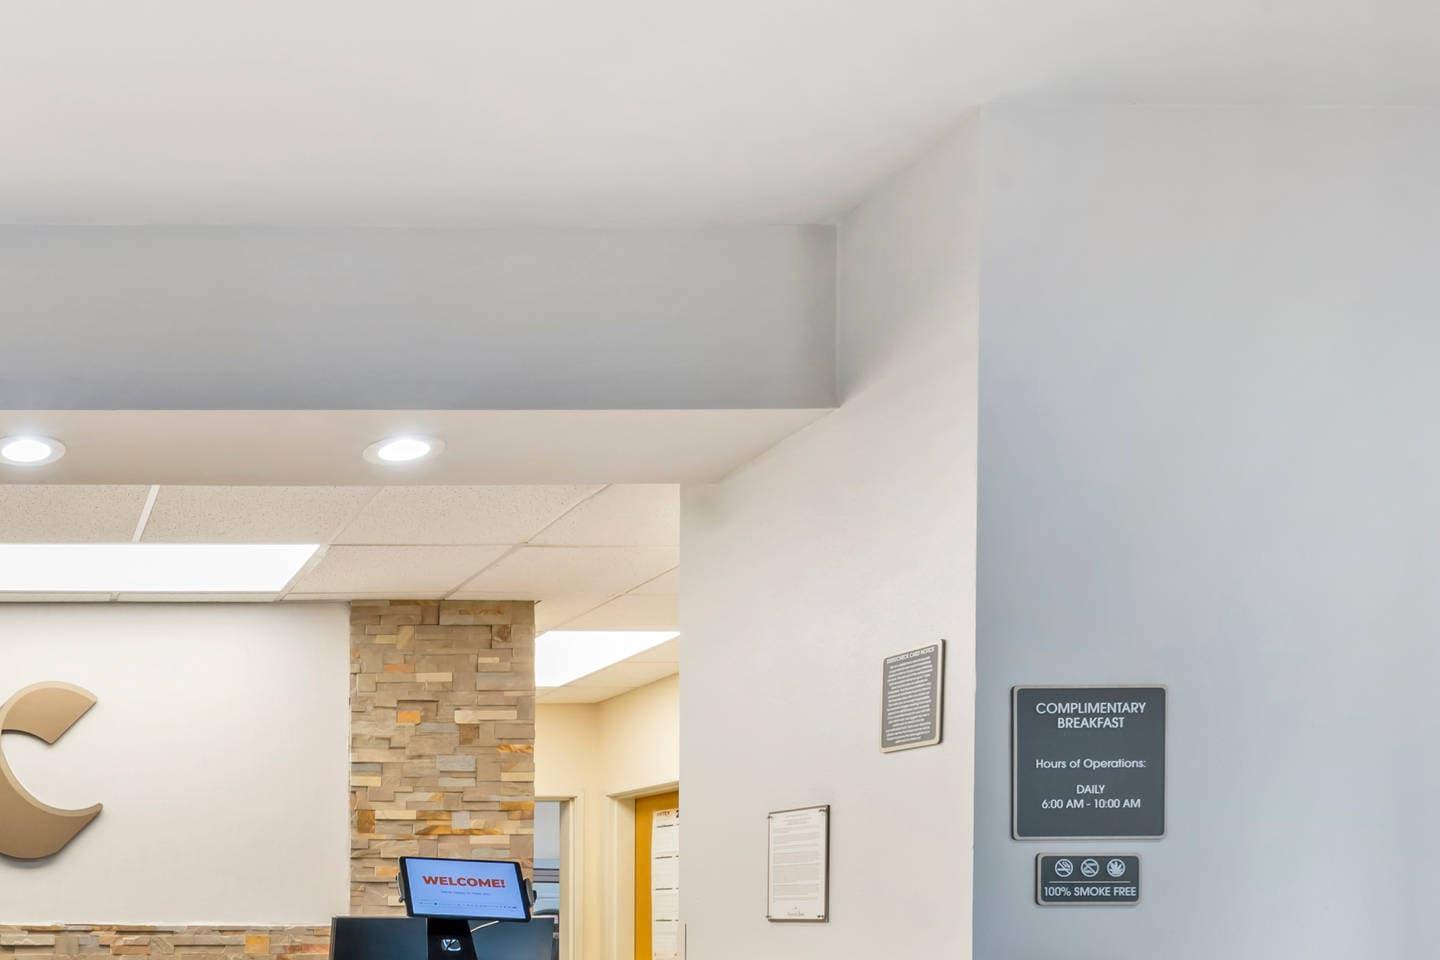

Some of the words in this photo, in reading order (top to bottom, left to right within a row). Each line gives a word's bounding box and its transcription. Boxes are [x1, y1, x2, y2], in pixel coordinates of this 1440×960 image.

[1035, 702, 1147, 714] COMPLIMENTARY
[1057, 717, 1125, 729] BREAKFAST
[1035, 759, 1067, 769] Hours
[1069, 758, 1081, 769] of
[1083, 758, 1147, 771] Operations:
[1076, 784, 1106, 794] DAILY
[1041, 799, 1064, 809] 6:00
[1065, 799, 1085, 809] AM
[1094, 798, 1120, 809] 10:00
[1122, 799, 1141, 809] AM
[422, 875, 506, 889] WELCOME!
[1044, 887, 1071, 897] 100%
[1073, 887, 1111, 897] SMOKE
[1113, 887, 1137, 897] FREE
